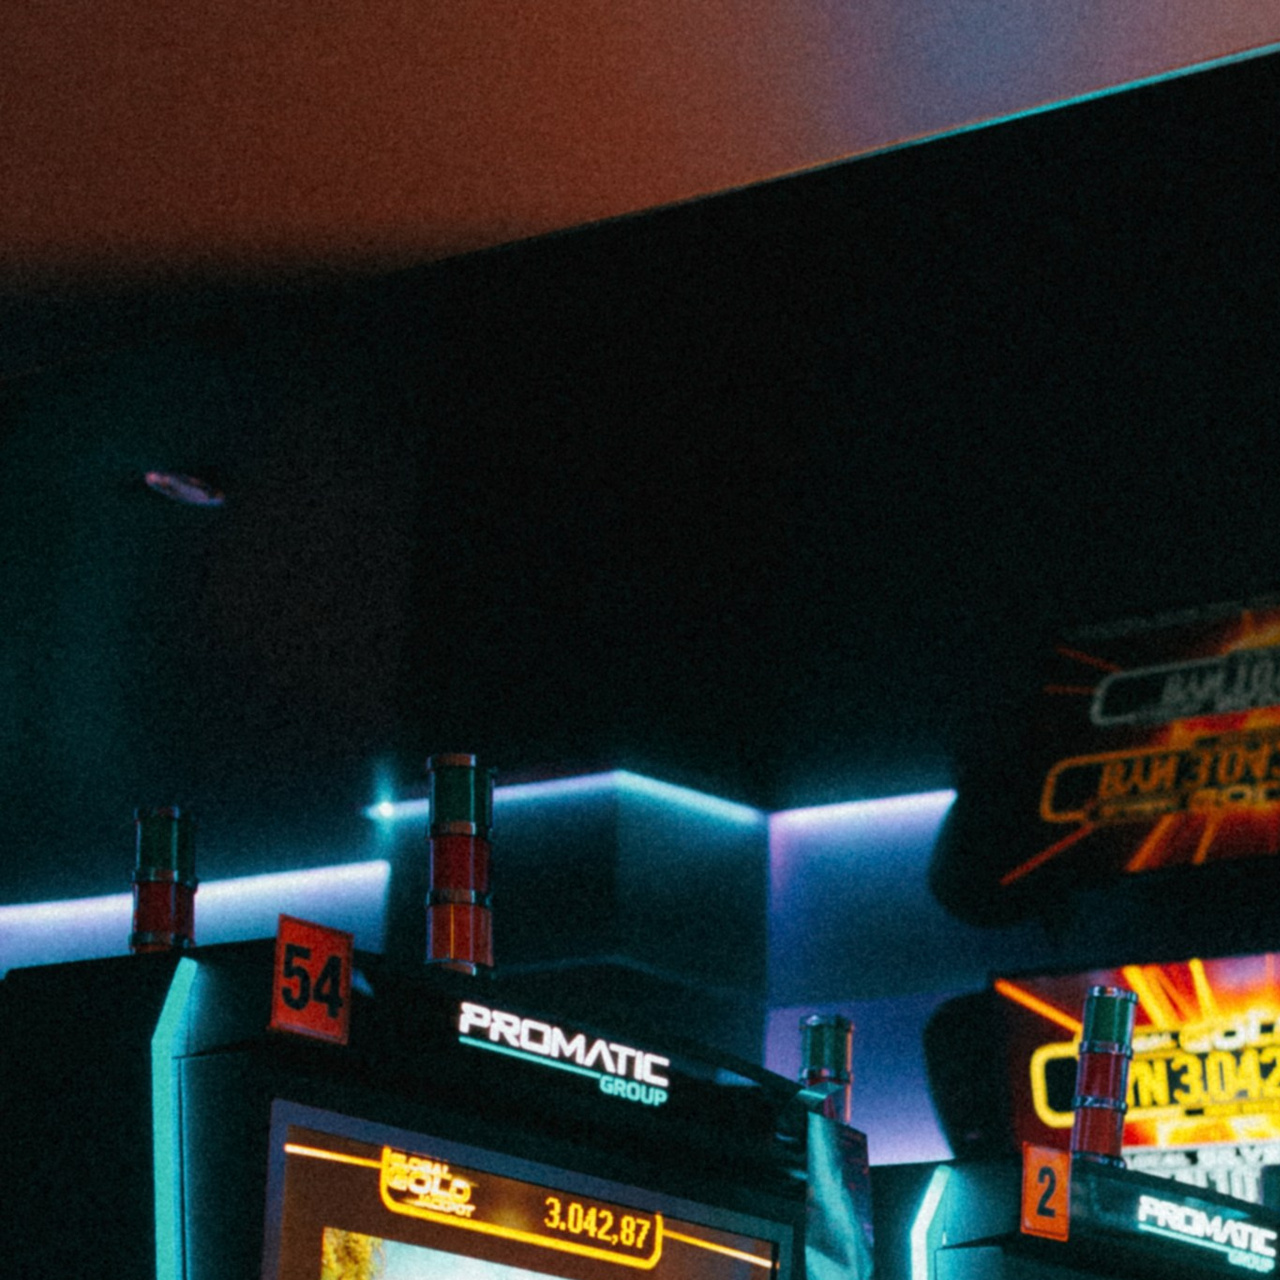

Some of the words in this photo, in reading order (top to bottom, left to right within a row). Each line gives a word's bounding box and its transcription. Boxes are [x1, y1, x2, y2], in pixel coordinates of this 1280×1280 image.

[282, 943, 343, 1019] 54
[459, 1001, 670, 1087] PROMATIC
[600, 1075, 667, 1107] GROUP
[387, 1166, 472, 1204] GOLD
[1037, 1166, 1057, 1218] 2
[544, 1197, 650, 1249] 3.042,87
[1138, 1195, 1277, 1257] PROMATIC
